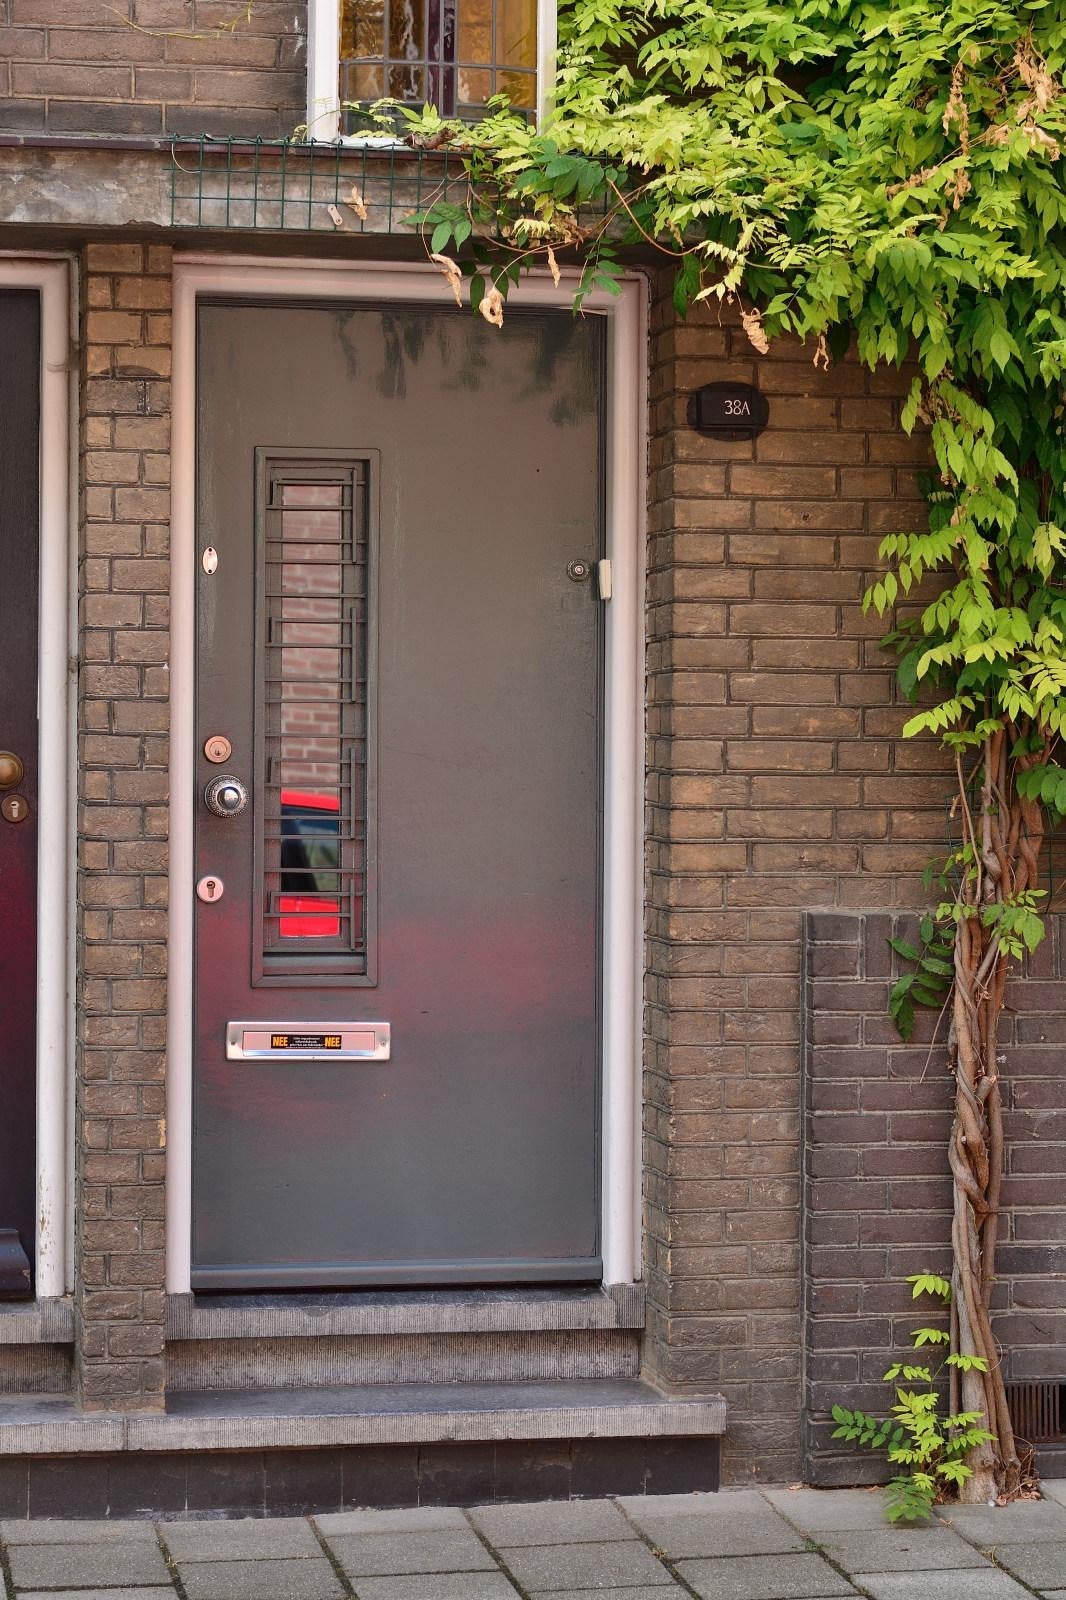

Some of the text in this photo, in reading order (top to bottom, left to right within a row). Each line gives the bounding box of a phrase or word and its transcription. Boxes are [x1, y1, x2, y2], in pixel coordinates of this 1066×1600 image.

[724, 399, 751, 416] 38A
[272, 1036, 289, 1047] NEE
[324, 1037, 341, 1047] NEE
